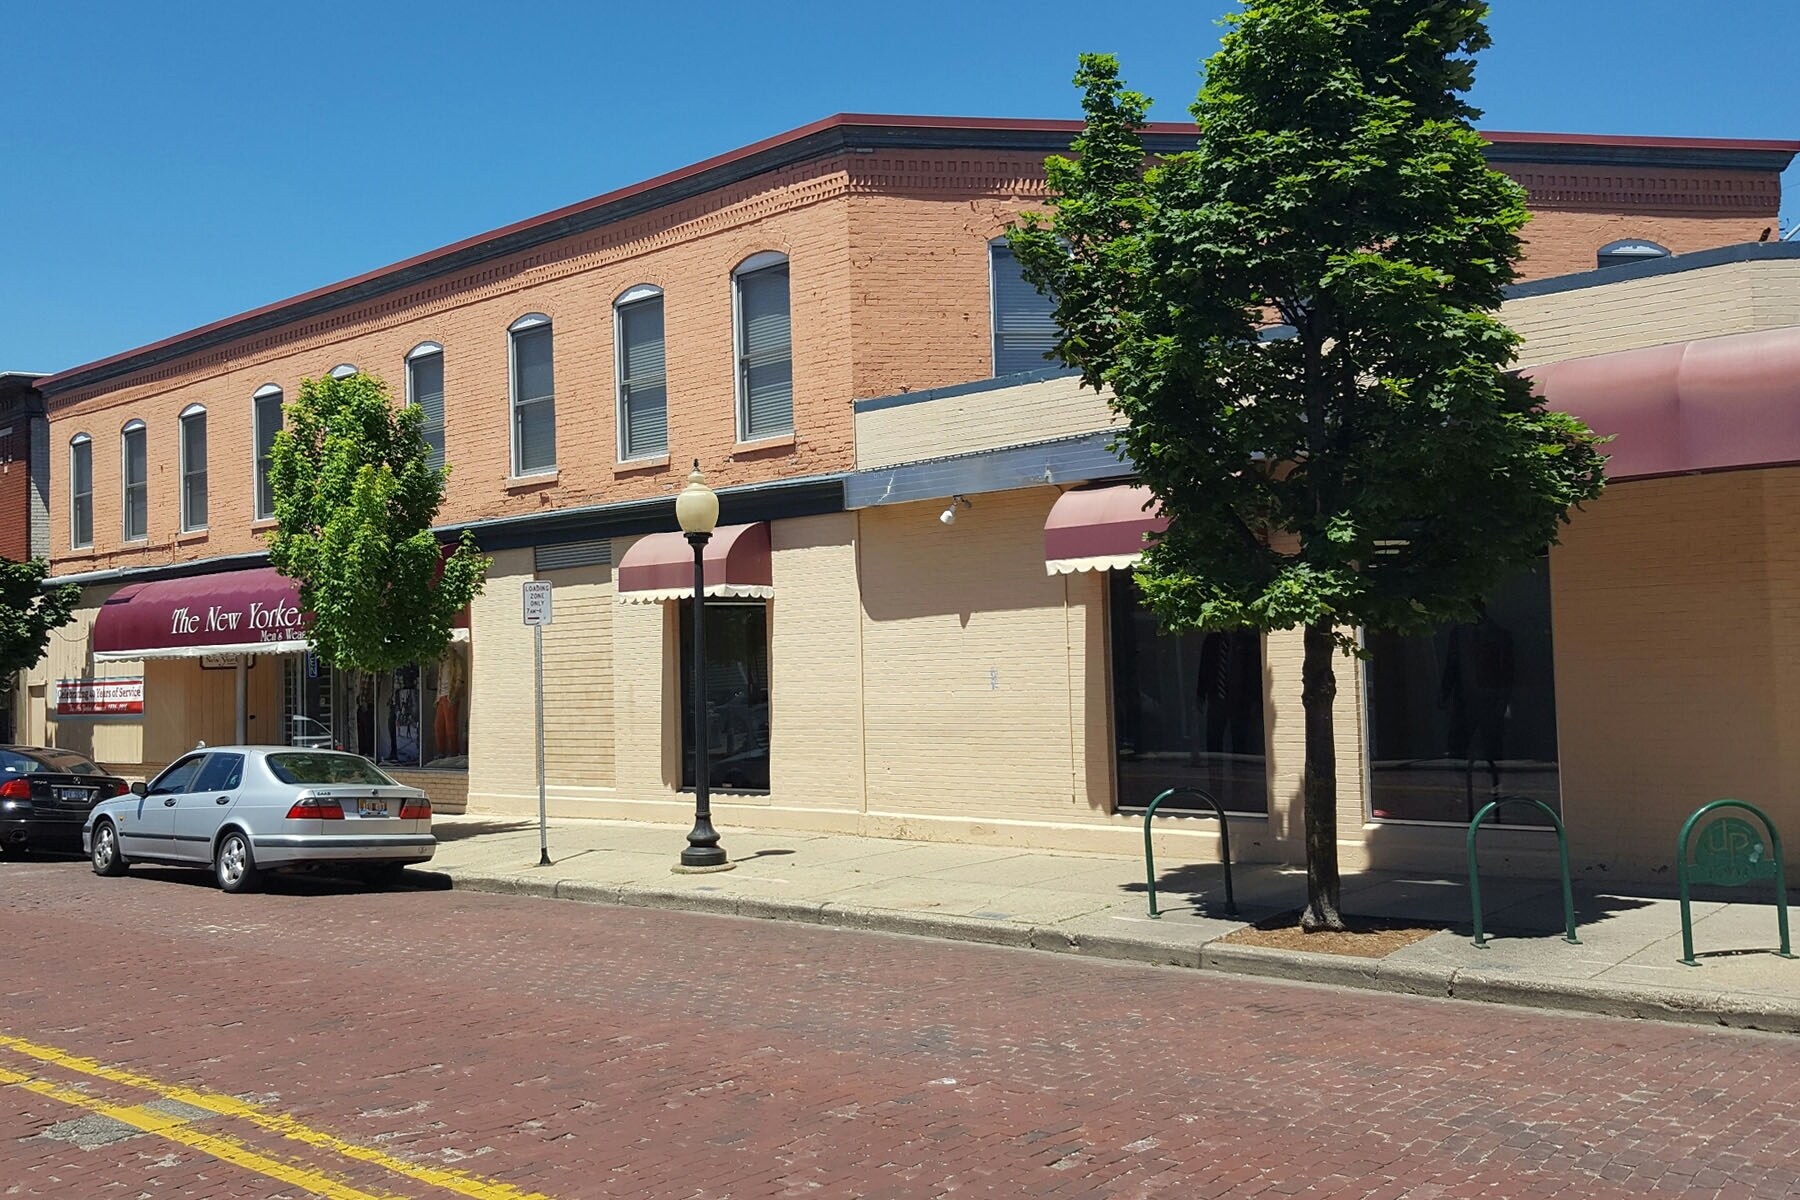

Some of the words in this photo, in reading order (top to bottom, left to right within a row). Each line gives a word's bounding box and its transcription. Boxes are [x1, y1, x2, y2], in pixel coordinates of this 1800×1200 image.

[171, 607, 199, 634] The
[205, 606, 242, 632] New
[260, 629, 282, 642] Men's
[96, 688, 111, 698] Years
[112, 686, 119, 697] of
[119, 685, 141, 697] Service
